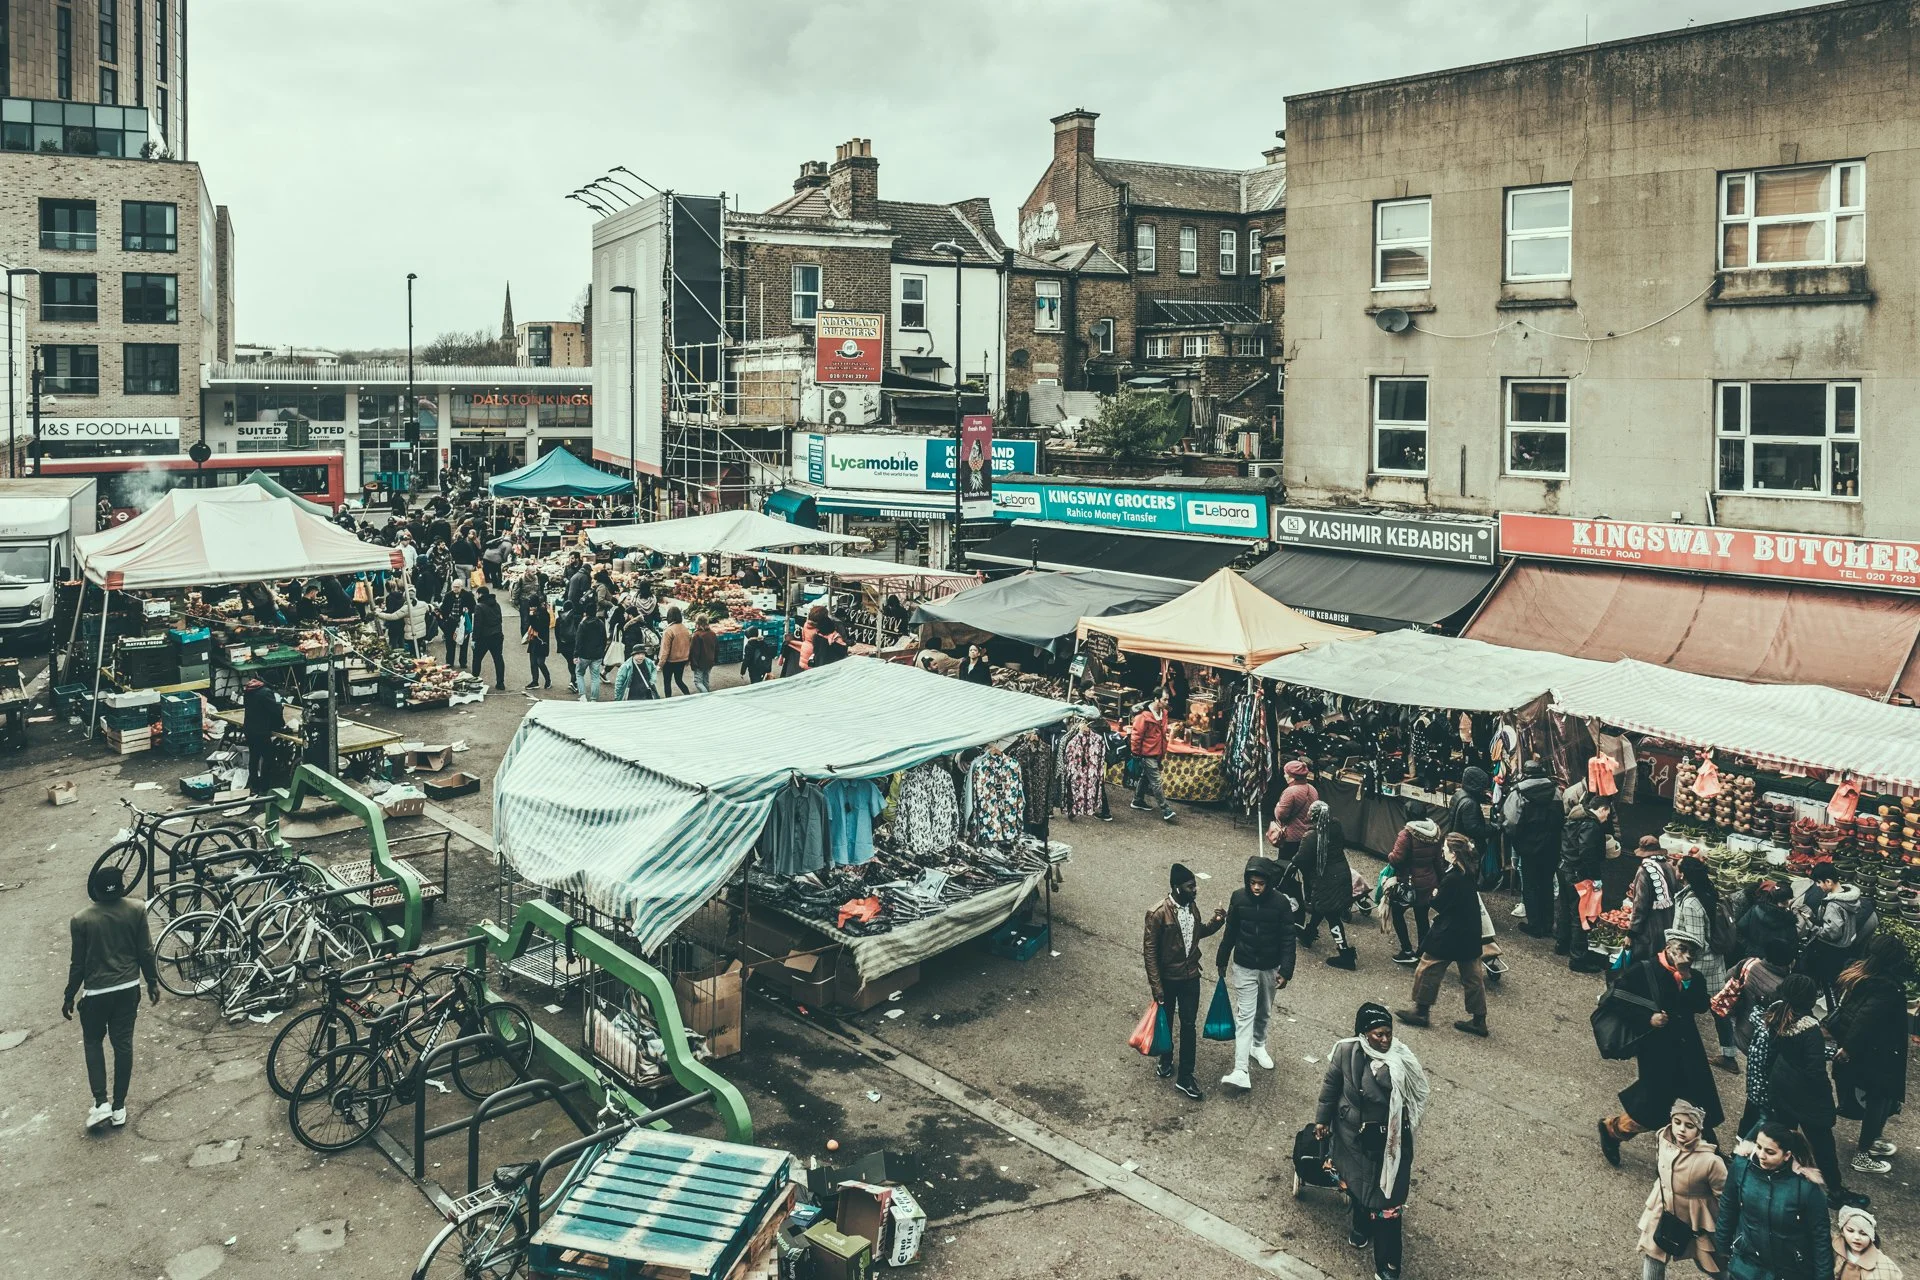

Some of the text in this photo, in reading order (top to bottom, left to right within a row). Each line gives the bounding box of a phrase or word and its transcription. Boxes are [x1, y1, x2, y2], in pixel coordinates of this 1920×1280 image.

[822, 317, 878, 326] KINGSLAND
[823, 327, 876, 336] BUTCHERS
[474, 394, 541, 406] DALSTON
[77, 423, 173, 435] FOODHALL
[831, 454, 918, 471] Lycamobile
[1001, 494, 1035, 505] Lebara
[1049, 490, 1176, 510] KINGSWAY GROCERS
[880, 509, 946, 519] KINGSLAND GROCERIES
[1067, 508, 1157, 522] Rahico Money Transfer
[1205, 504, 1249, 519] Lebara
[1309, 520, 1473, 553] KASHMIR KEBABISH
[1572, 522, 1735, 558] KINGSWAY
[1580, 548, 1613, 557] RIDLEY
[1616, 550, 1641, 559] ROAD
[1839, 570, 1916, 584] TEL. 020 7923
[1316, 611, 1349, 623] KEBABISH
[420, 1008, 450, 1061] RIDDICK
